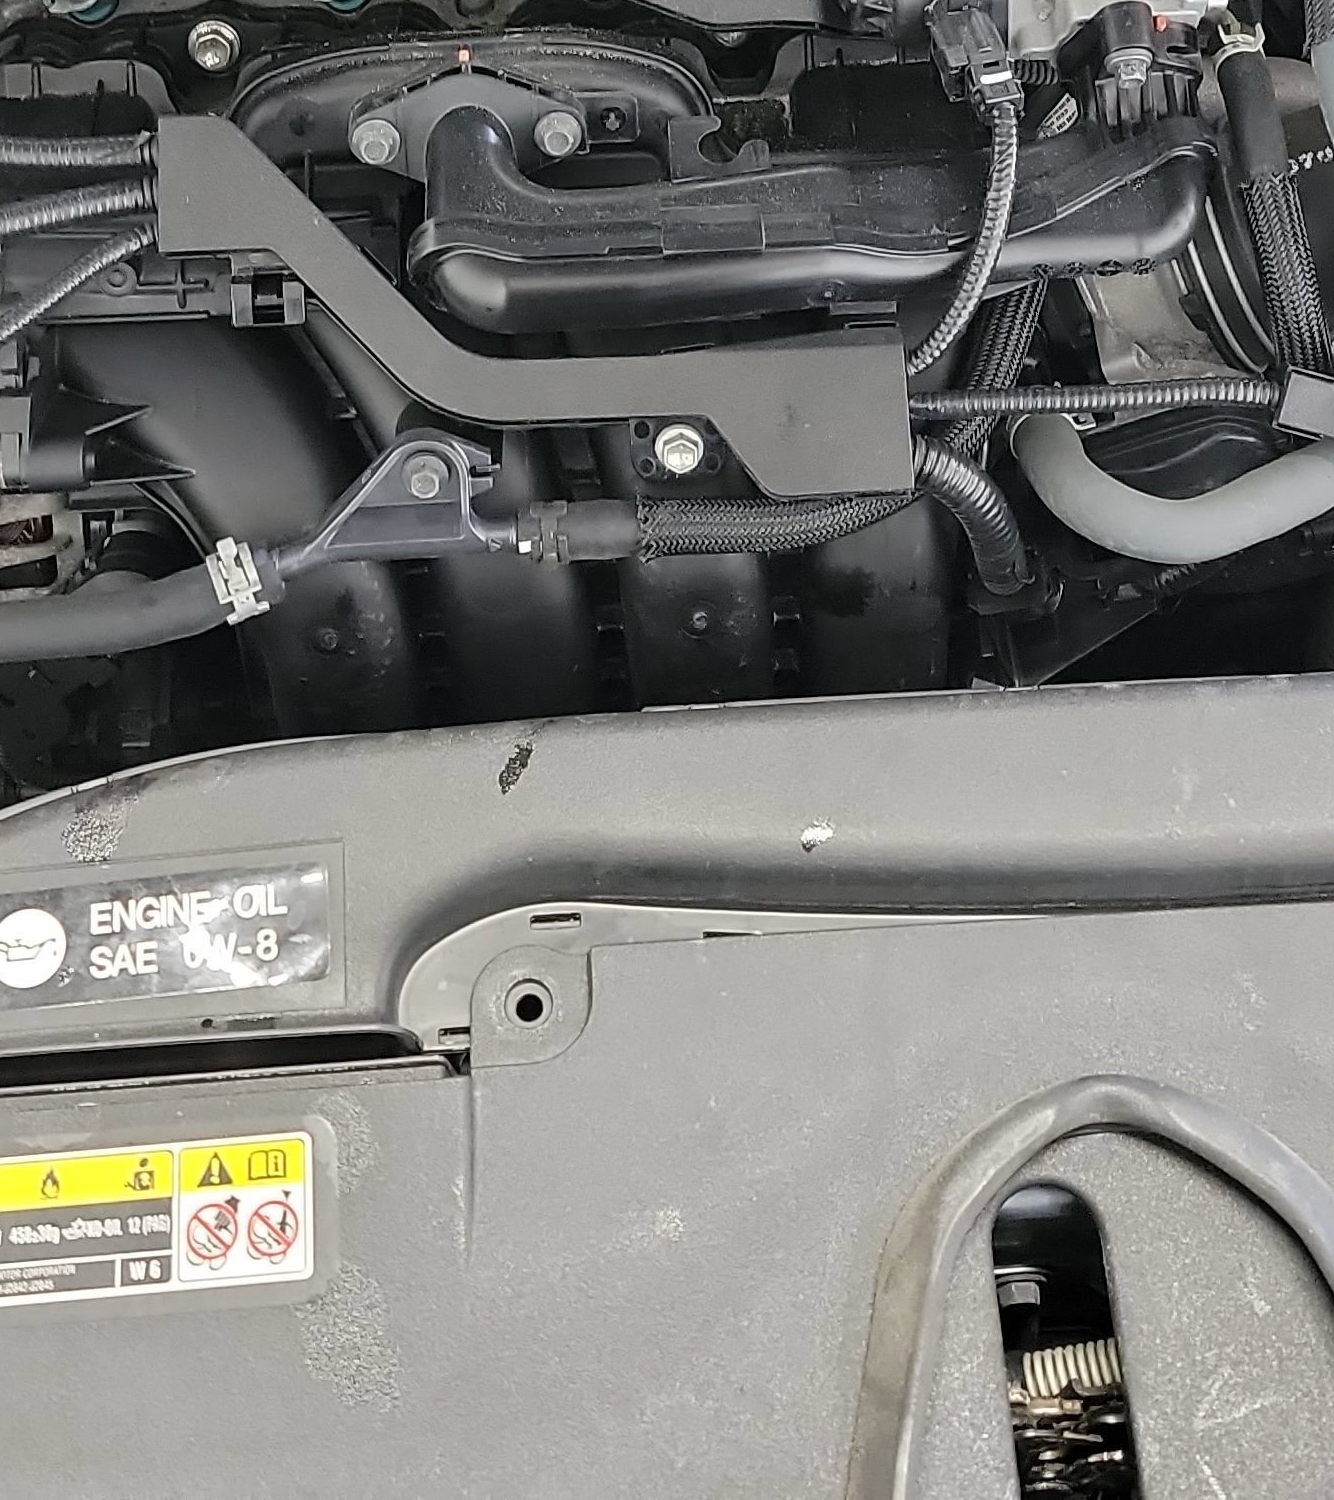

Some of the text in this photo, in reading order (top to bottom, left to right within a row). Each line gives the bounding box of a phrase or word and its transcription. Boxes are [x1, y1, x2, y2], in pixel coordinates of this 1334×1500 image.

[89, 883, 288, 936] ENGINE OIL
[89, 940, 159, 980] SAE
